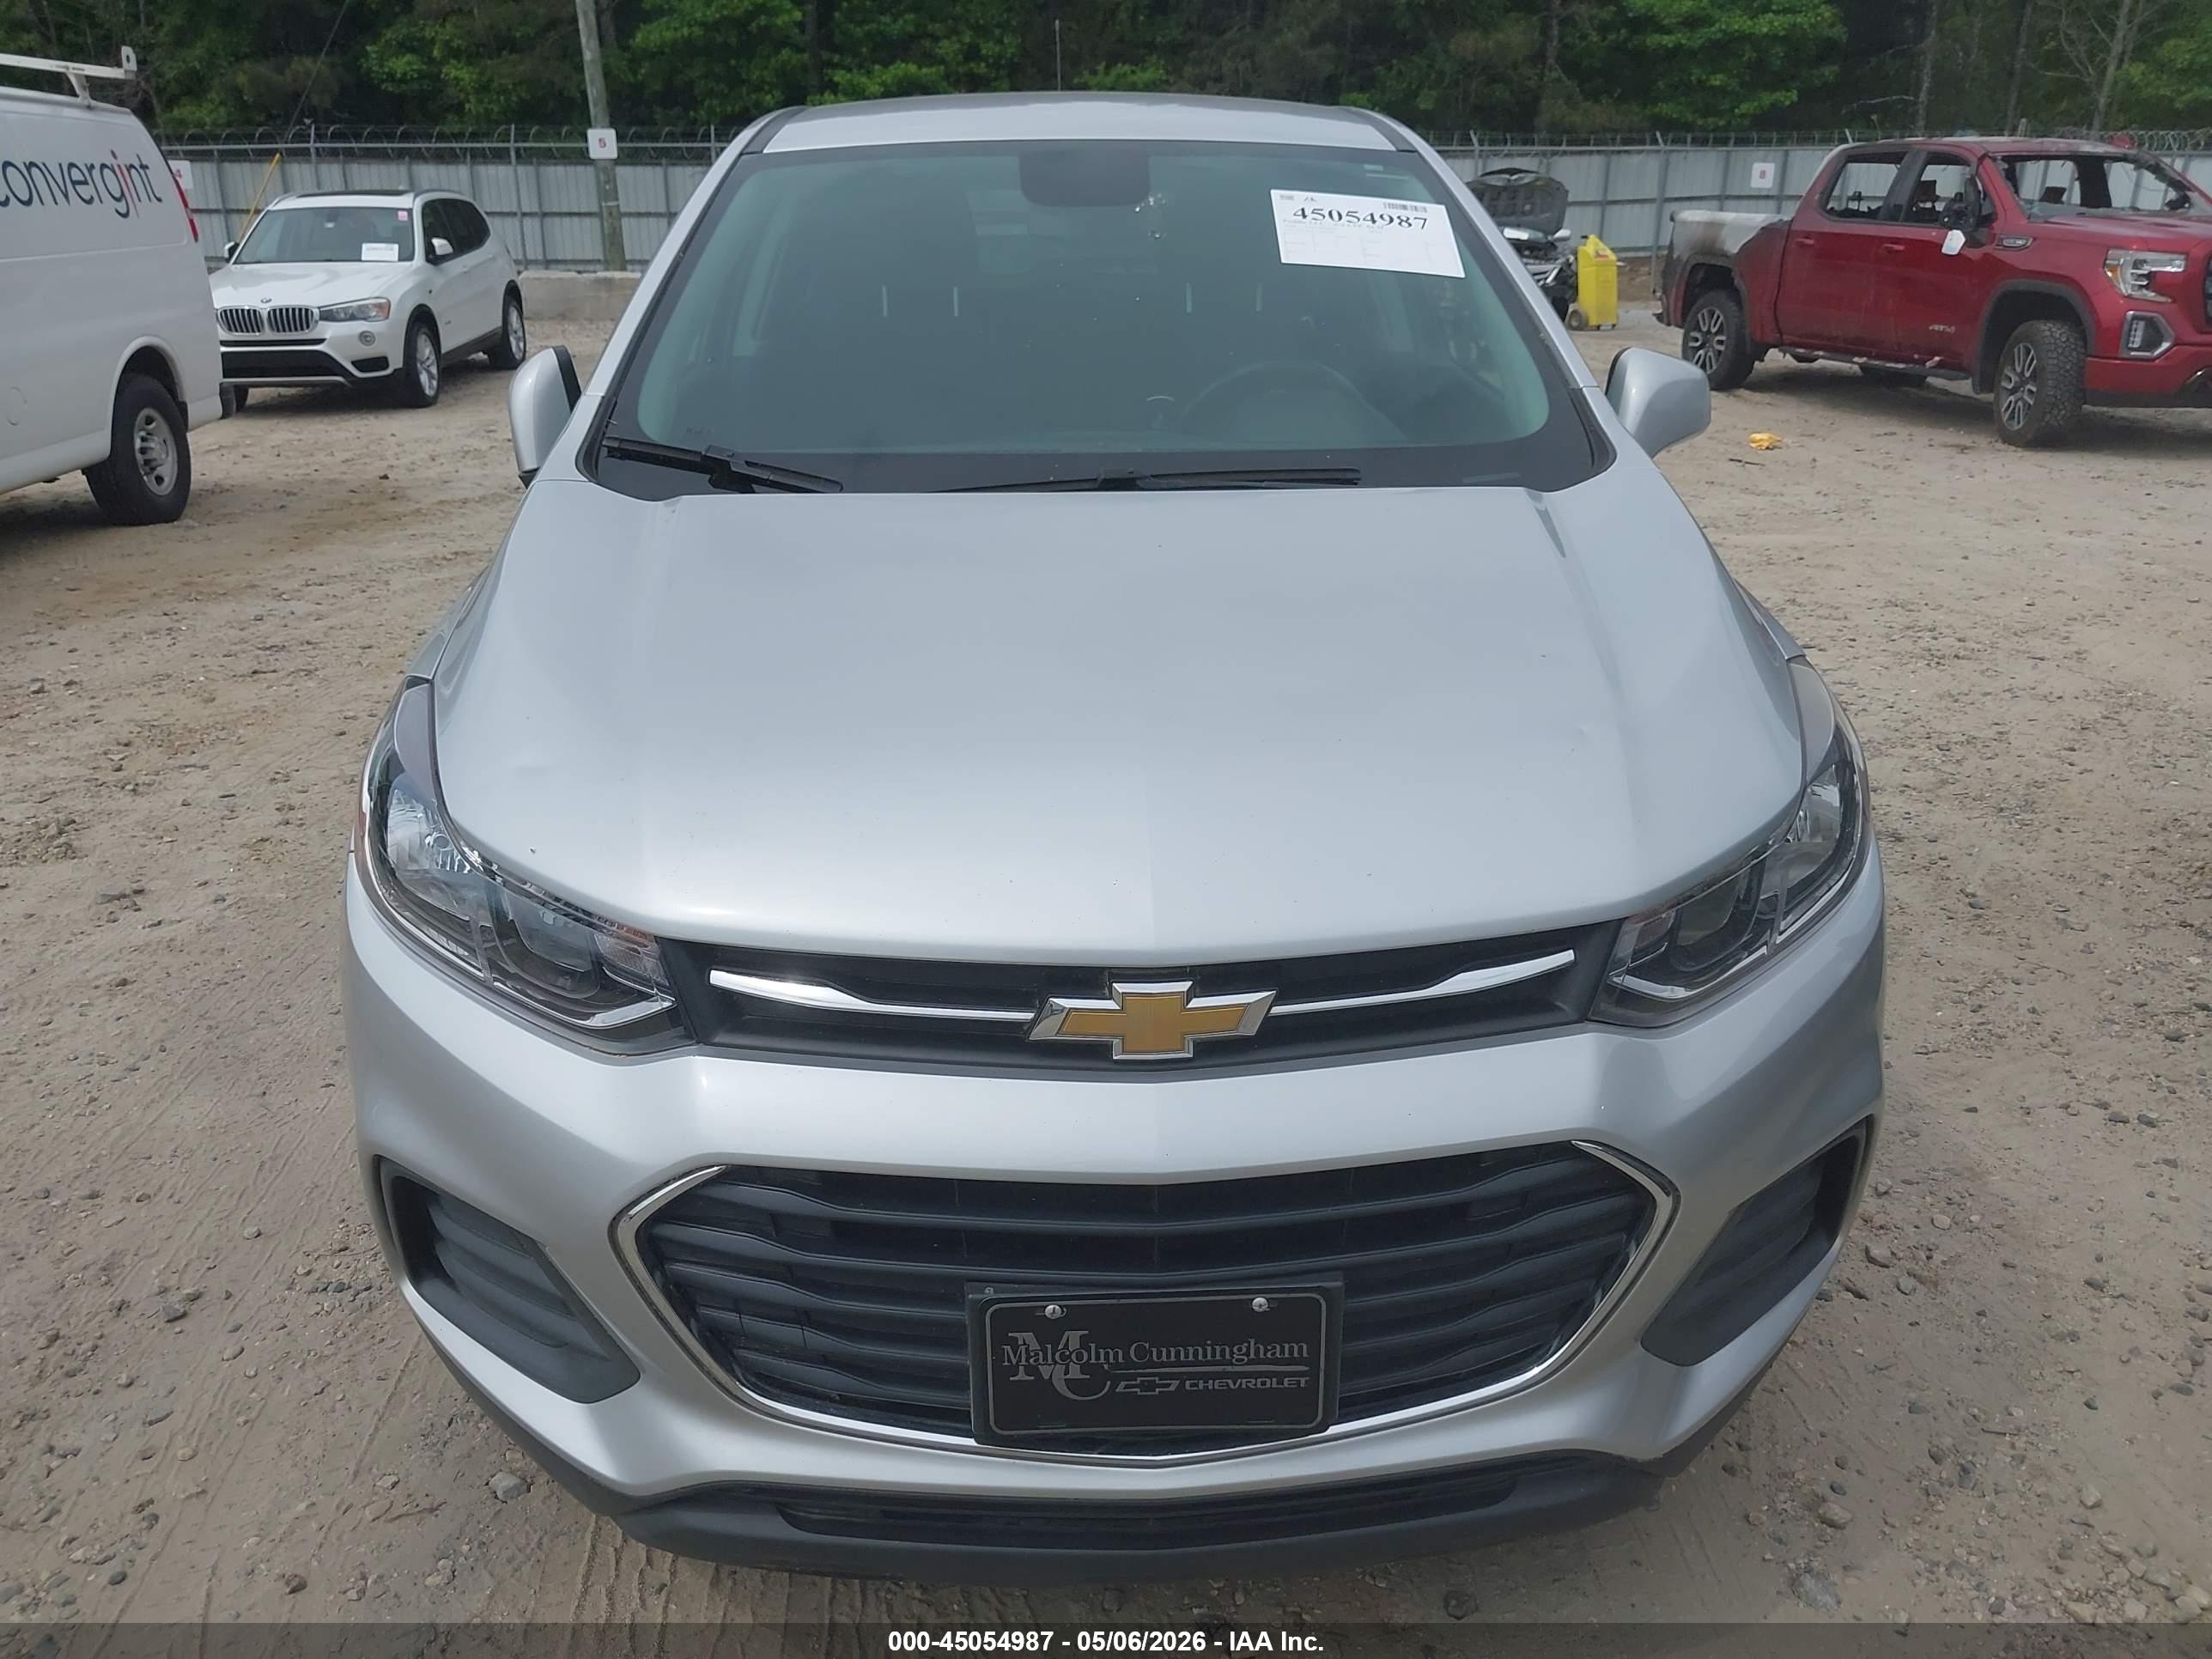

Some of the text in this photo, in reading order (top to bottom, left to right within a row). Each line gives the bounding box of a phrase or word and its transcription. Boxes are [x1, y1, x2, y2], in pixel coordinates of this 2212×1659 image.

[598, 137, 606, 149] 5
[1292, 206, 1429, 231] 45054987
[1002, 1339, 1309, 1365] Malcolm Cunningham
[1185, 1376, 1310, 1390] CHEVROLET
